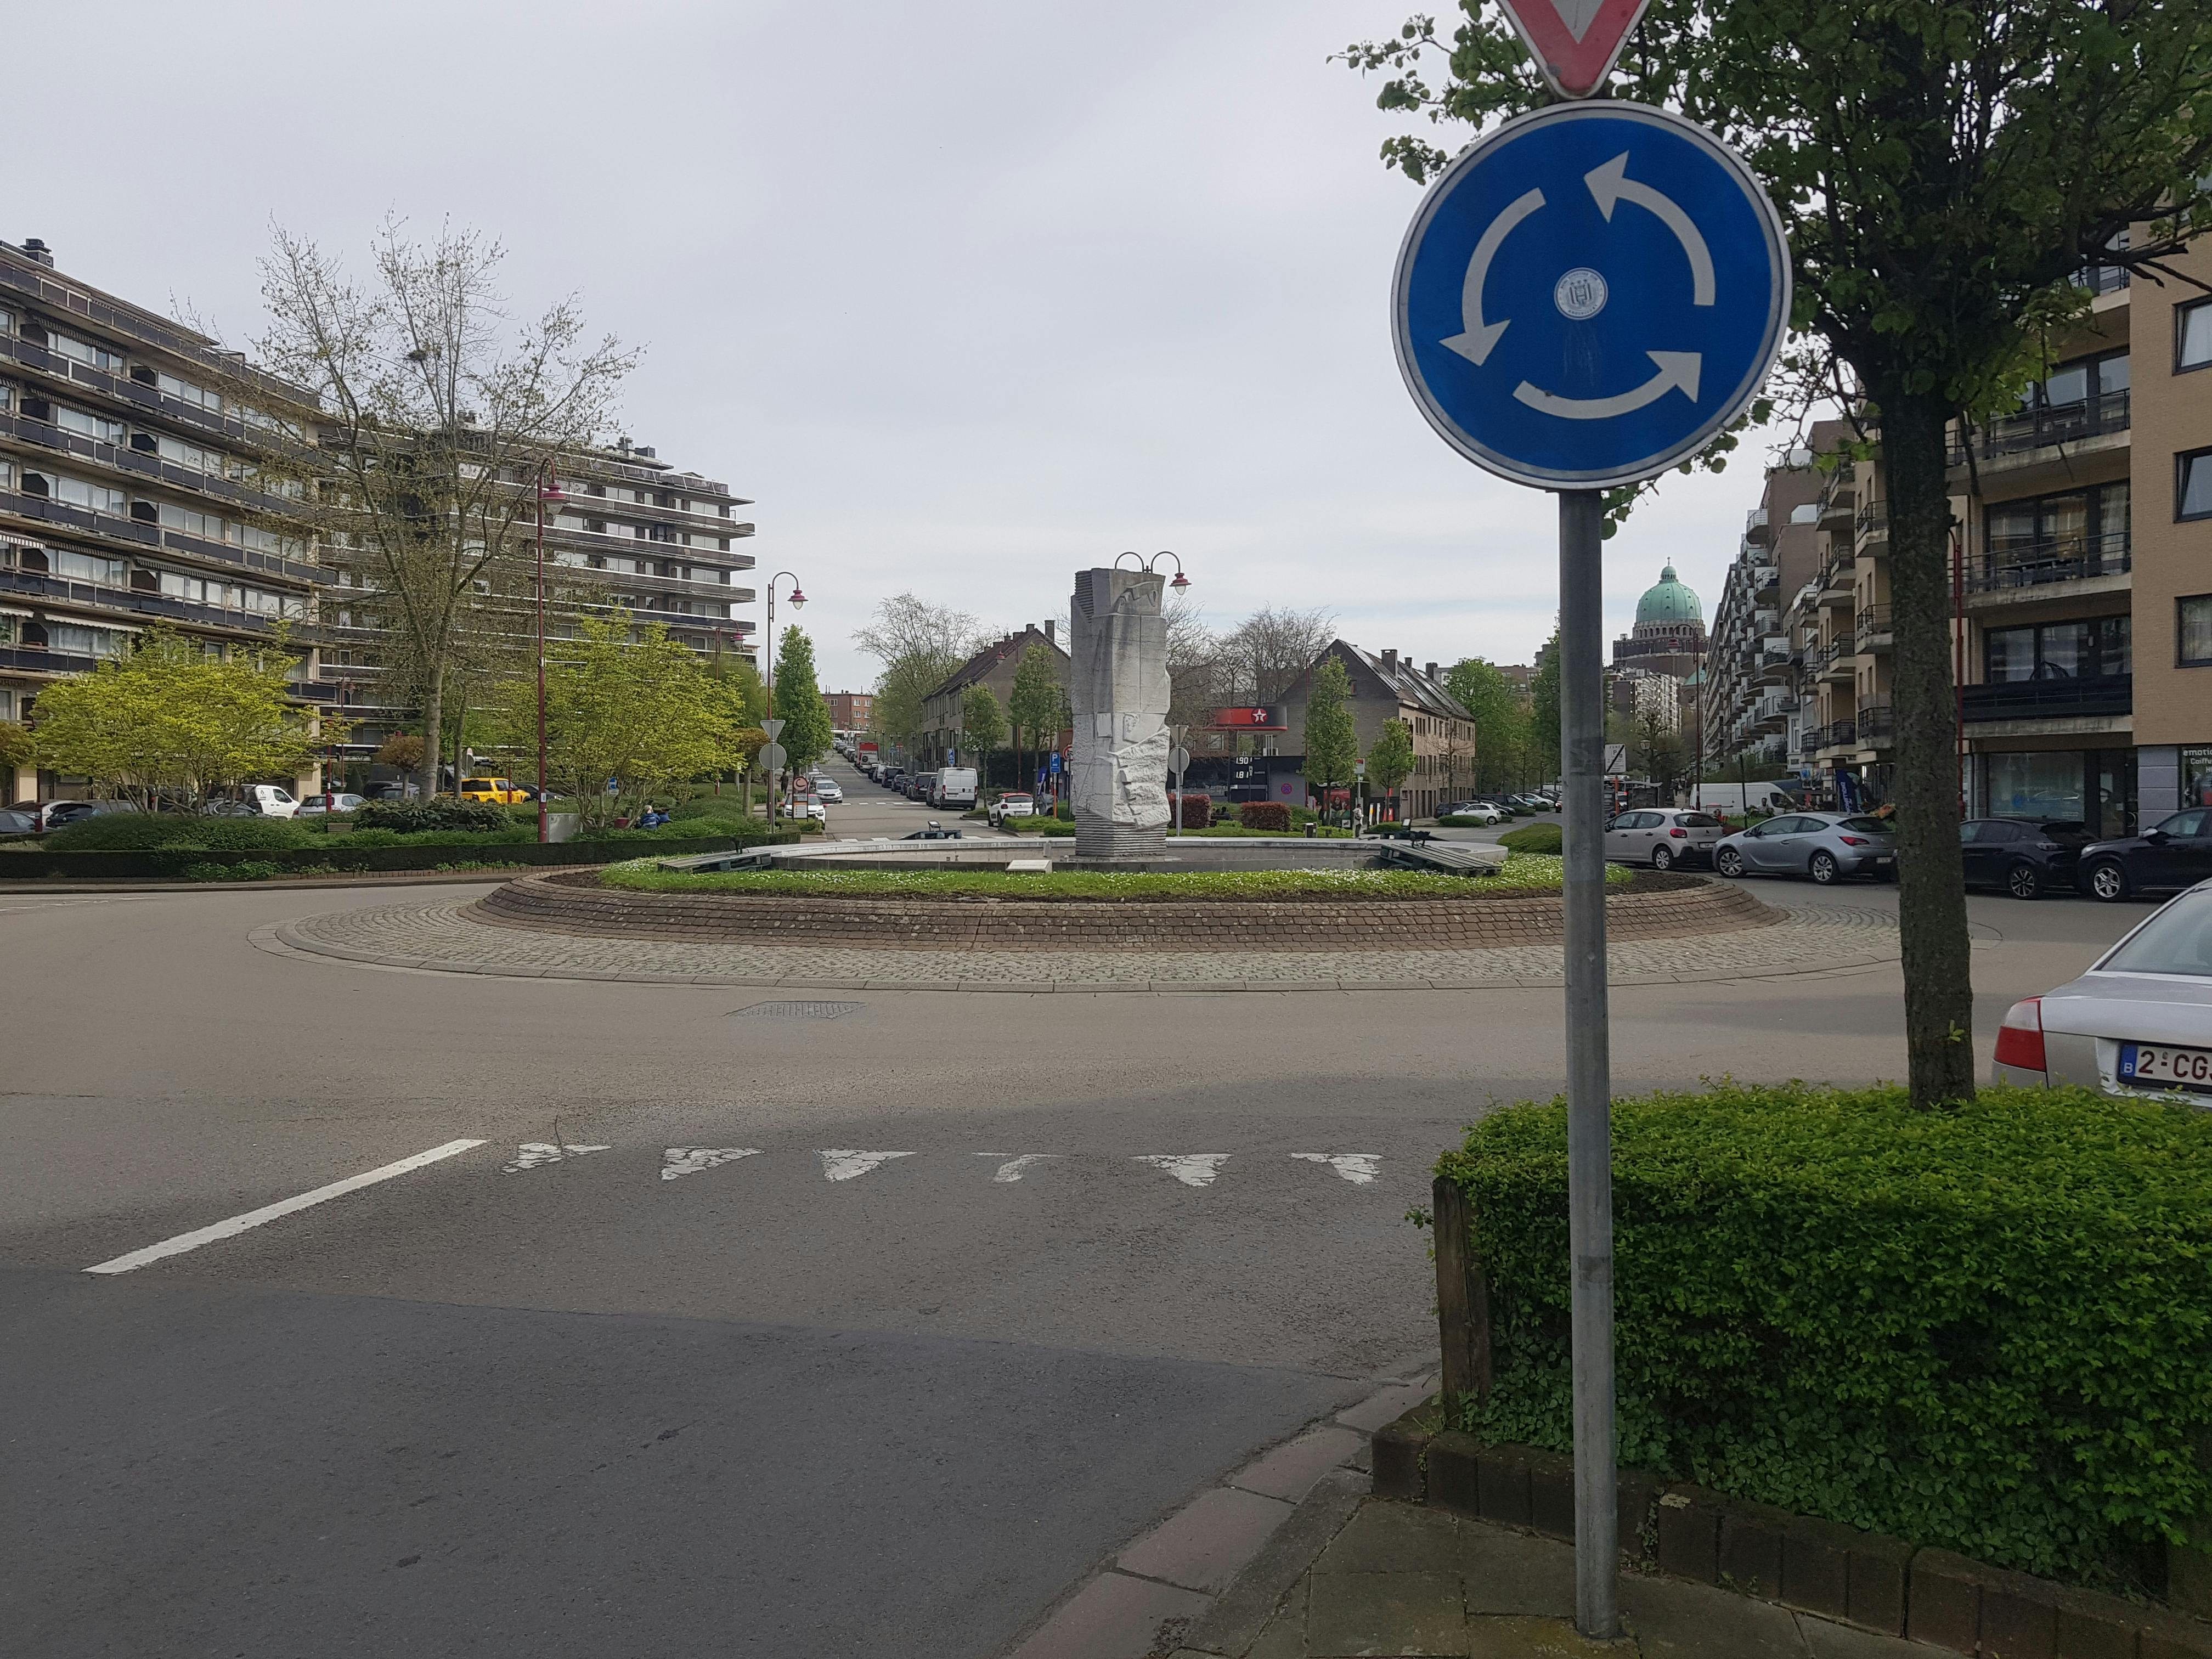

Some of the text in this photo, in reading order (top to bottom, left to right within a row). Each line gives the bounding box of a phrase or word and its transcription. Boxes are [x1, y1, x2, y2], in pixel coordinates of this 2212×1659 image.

[1052, 754, 1058, 762] P
[2124, 1062, 2133, 1073] B
[2138, 1050, 2212, 1080] 2-CG
